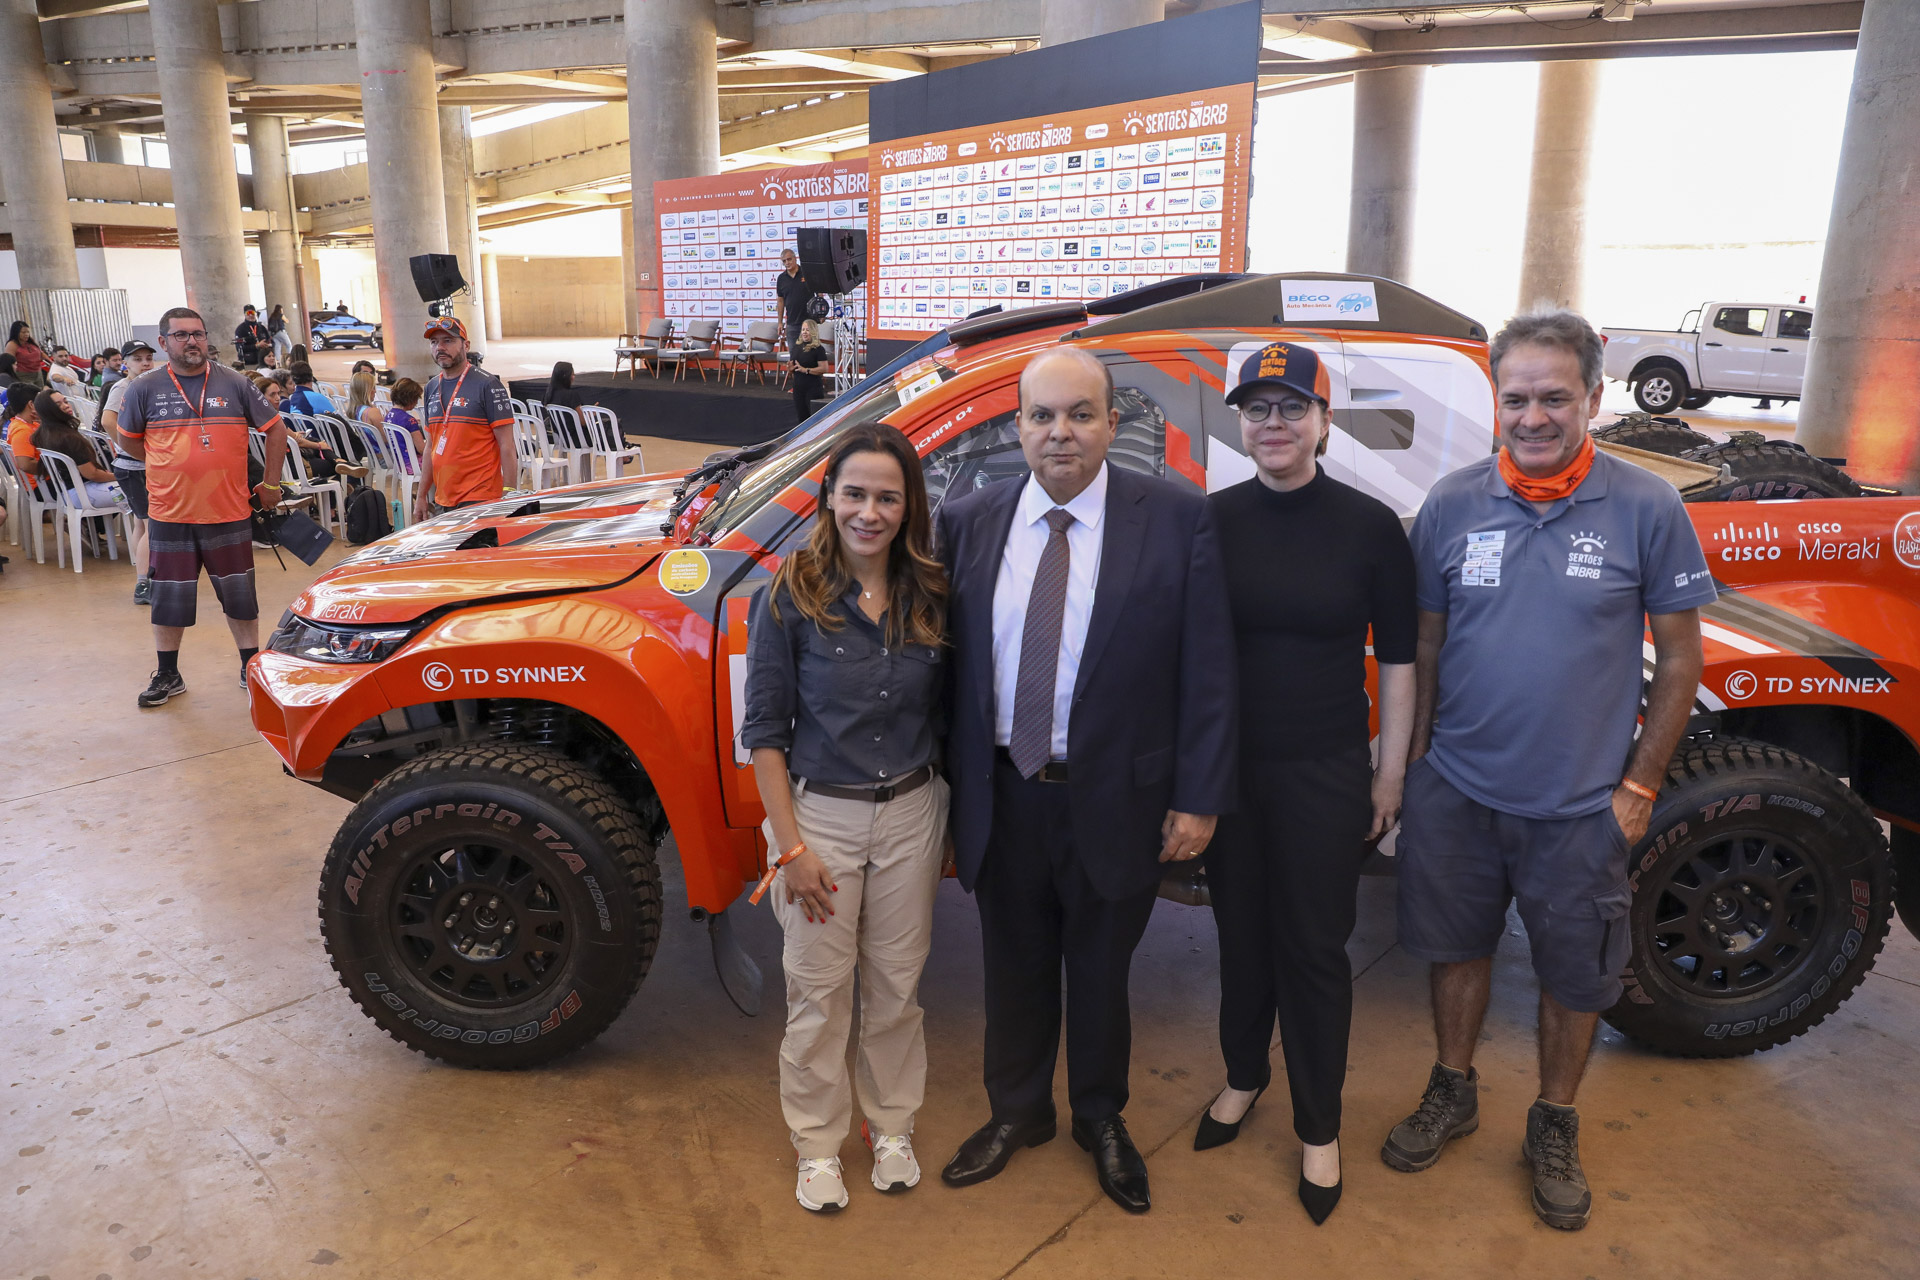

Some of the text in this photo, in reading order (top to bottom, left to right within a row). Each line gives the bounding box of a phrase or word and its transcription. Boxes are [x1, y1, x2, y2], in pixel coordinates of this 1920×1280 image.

[1146, 103, 1228, 134] SERTÕES BRB
[1007, 130, 1041, 152] SERTÕES
[1051, 126, 1072, 146] BRB
[895, 148, 923, 167] SERTÕES
[931, 144, 948, 161] BRB
[786, 172, 869, 199] SERTÕES BR
[1267, 367, 1286, 377] BRB
[1568, 552, 1604, 566] SERTÕES
[1798, 537, 1881, 560] Meraki
[1579, 566, 1601, 580] BRB
[459, 666, 587, 684] TD SYNNEX
[1765, 677, 1891, 694] TD SYNNEX
[1699, 793, 1761, 822] T/A
[344, 802, 522, 905] All-Terrain
[533, 822, 587, 875] T/A
[1704, 879, 1870, 1039] BFGoodrich
[364, 972, 582, 1044] BFGoodrich
